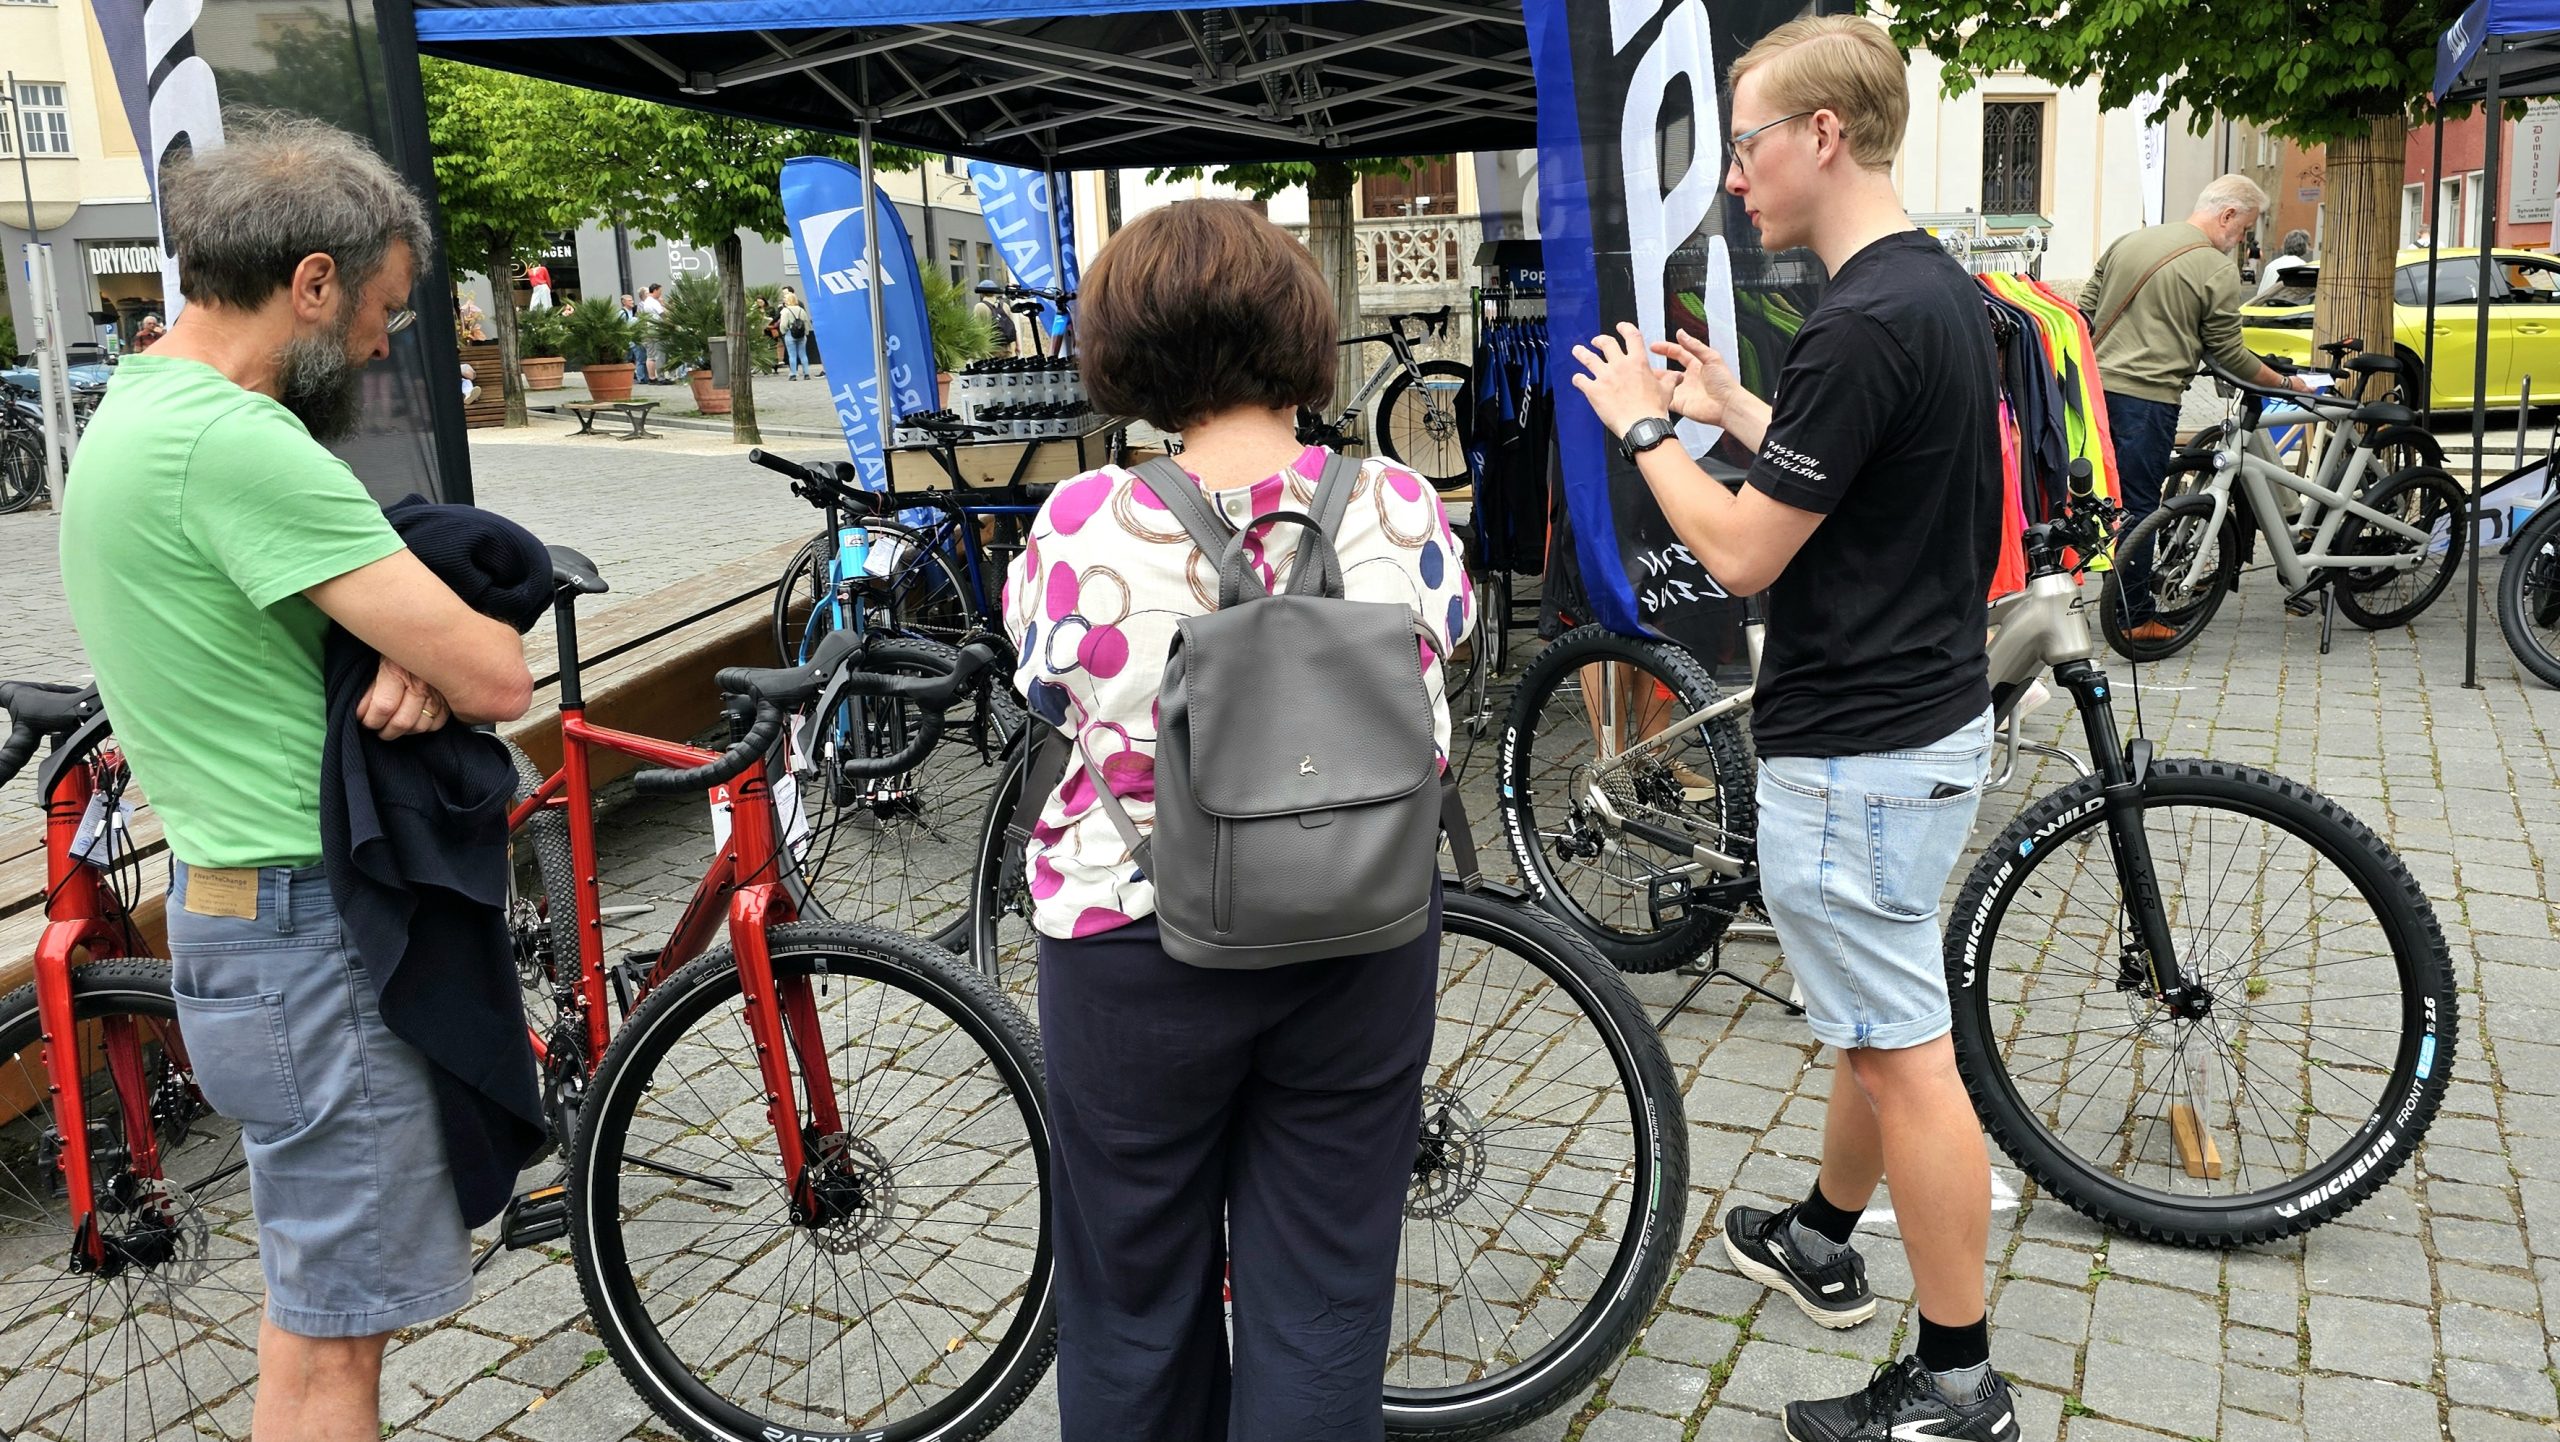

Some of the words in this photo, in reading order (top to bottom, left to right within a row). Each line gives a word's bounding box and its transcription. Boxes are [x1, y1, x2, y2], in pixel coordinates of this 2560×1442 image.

[89, 246, 163, 275] DRYKORN
[1360, 361, 1392, 402] corratec
[1763, 451, 1775, 459] OF
[1773, 457, 1827, 480] CYCLING
[1767, 441, 1820, 467] PASSION
[1620, 740, 1654, 763] XVERT
[1506, 807, 1542, 886] MICHELIN
[2134, 868, 2155, 910] XCR
[1963, 861, 2014, 968] MICHELIN
[848, 947, 900, 965] G-ONE
[2424, 996, 2436, 1022] 2.6
[2396, 1079, 2424, 1129] FRONT
[1648, 1097, 1662, 1159] SCHWALBE
[2299, 1130, 2396, 1211] MICHELIN
[1643, 1212, 1656, 1246] PLUS
